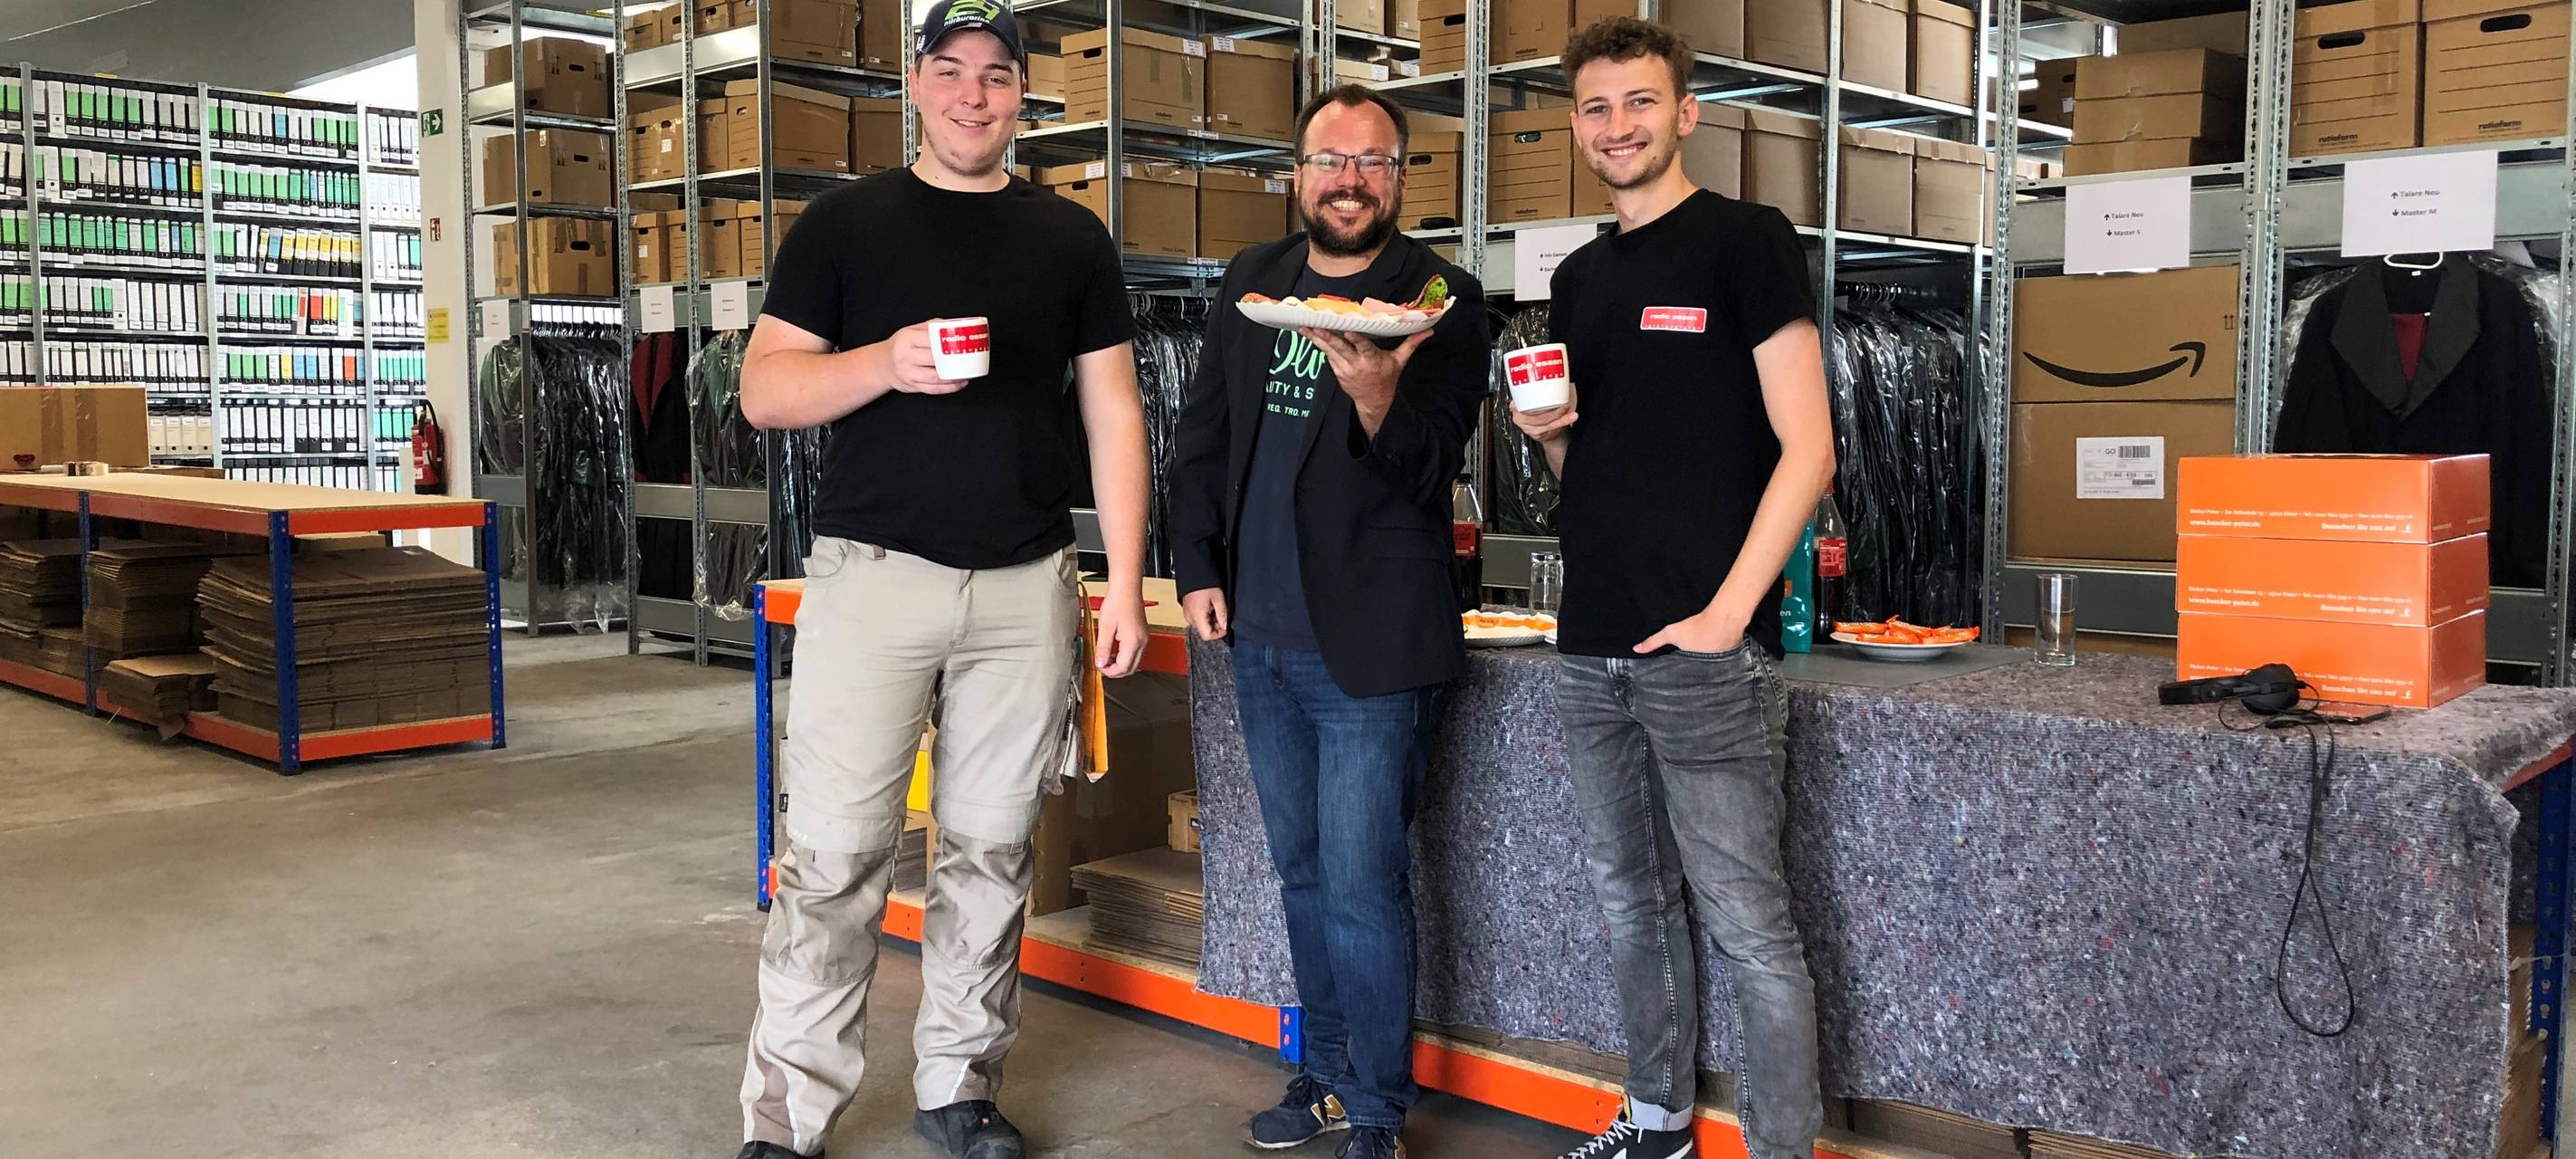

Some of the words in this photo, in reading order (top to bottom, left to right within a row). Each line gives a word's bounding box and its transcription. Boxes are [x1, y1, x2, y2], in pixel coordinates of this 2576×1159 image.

[2478, 120, 2522, 129] ratioform
[2318, 133, 2358, 143] ratioform
[942, 334, 967, 343] radio
[1511, 362, 1533, 373] radio
[1536, 359, 1562, 368] essen
[1293, 386, 1301, 398] &
